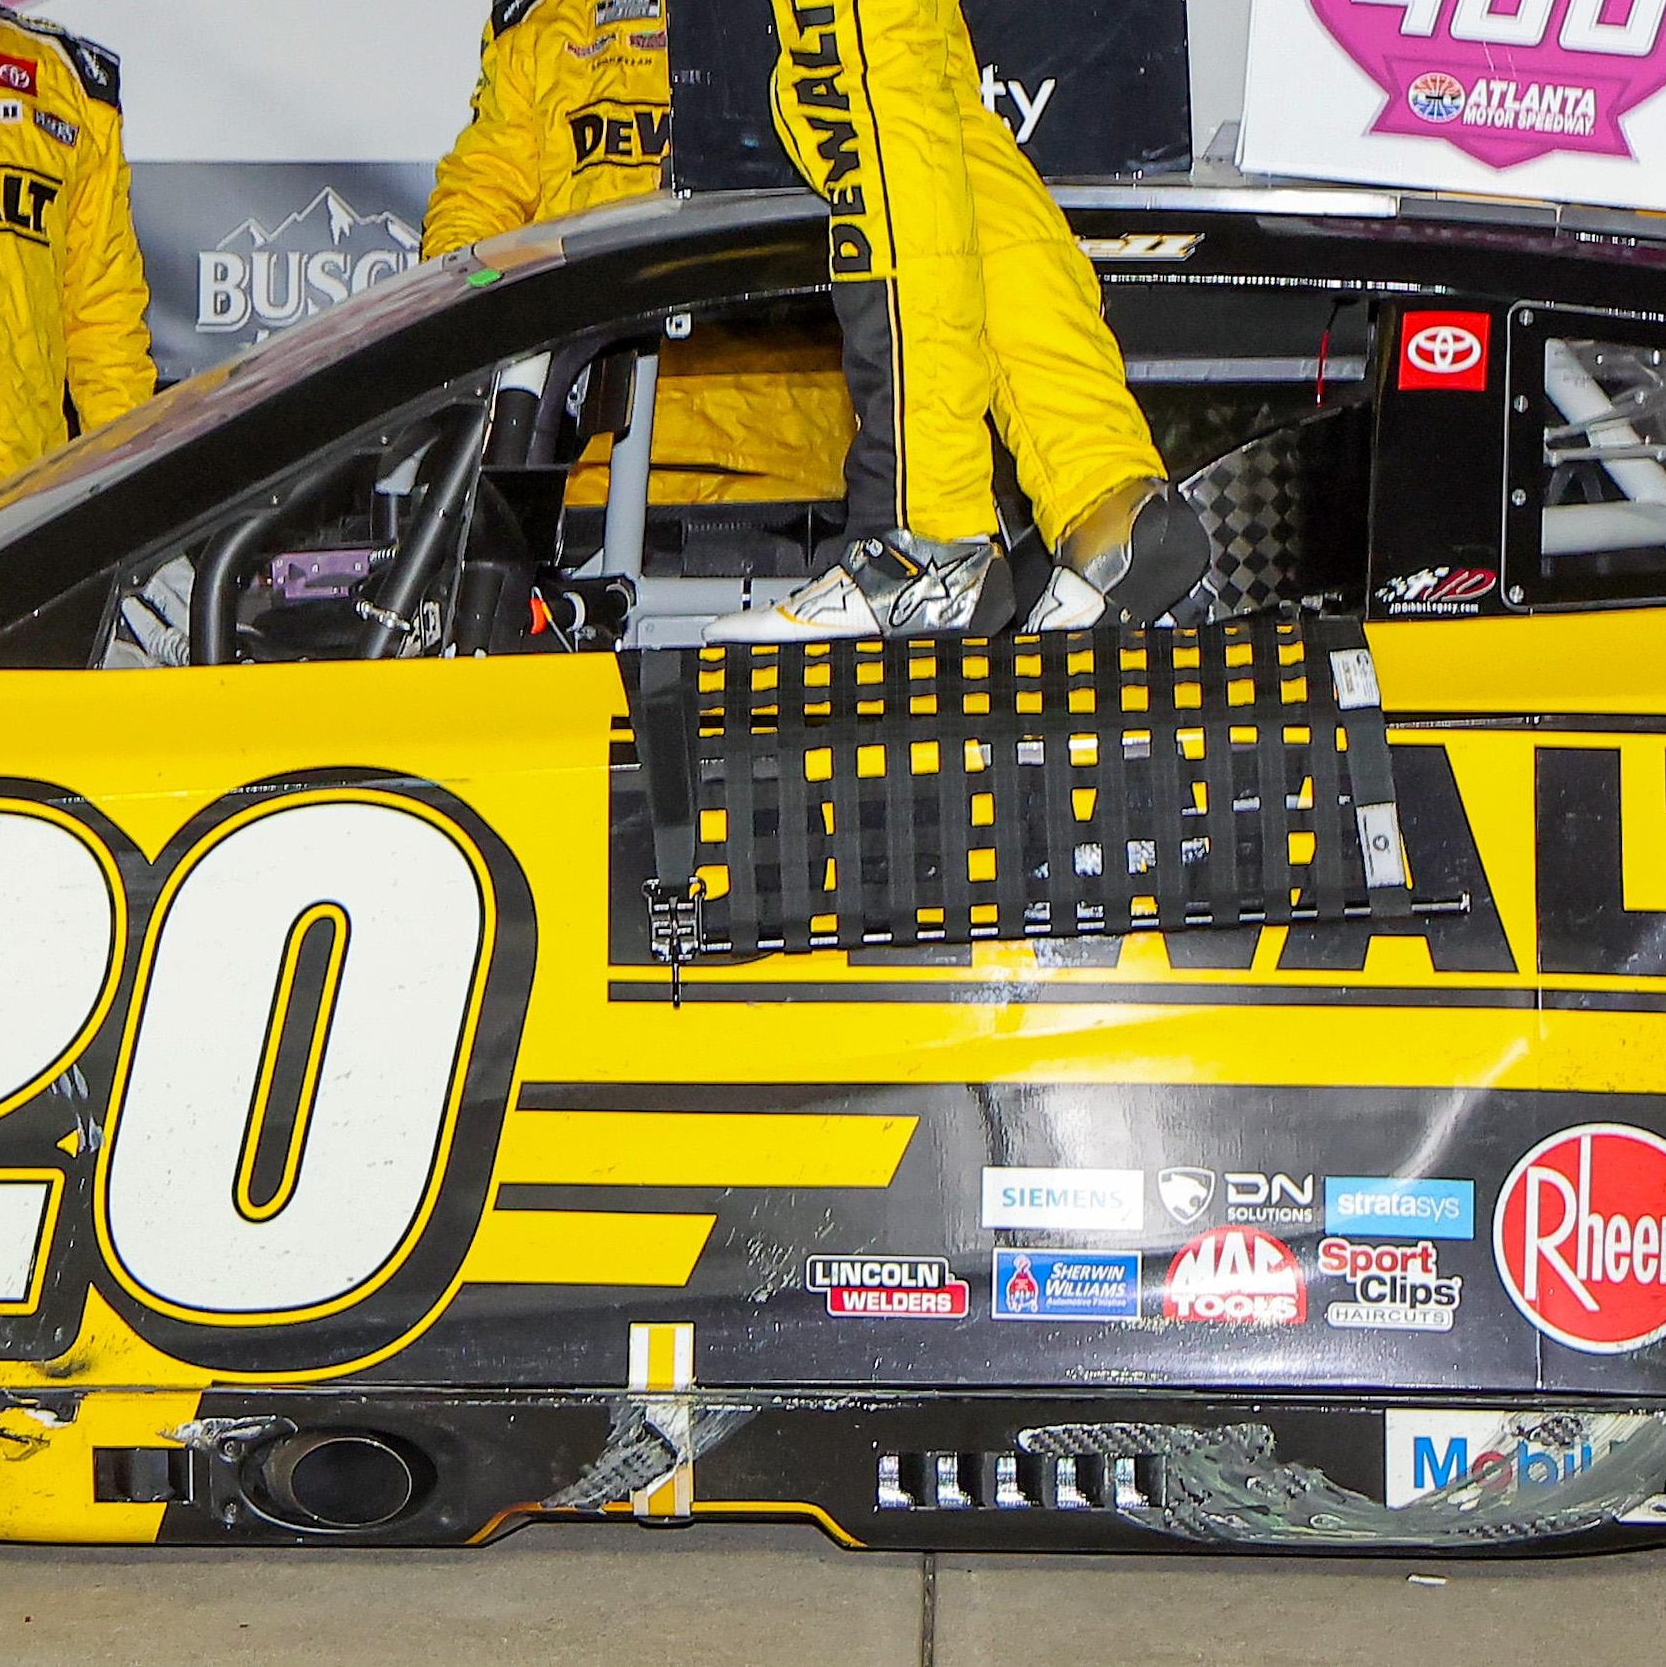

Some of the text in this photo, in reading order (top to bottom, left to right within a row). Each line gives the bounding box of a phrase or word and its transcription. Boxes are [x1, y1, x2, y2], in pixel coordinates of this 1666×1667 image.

[1465, 78, 1597, 118] ATLANTA
[570, 110, 671, 164] DEW
[1462, 107, 1595, 136] MOTOR SPEEDWAY
[790, 1, 874, 276] DEWALT
[1001, 1186, 1125, 1209] SIEMENS
[1225, 1173, 1315, 1206] DN
[1337, 1189, 1460, 1222] stratasys
[1227, 1206, 1313, 1222] SOLUTIONS
[814, 1261, 940, 1289] LINCOLN
[1051, 1262, 1126, 1282] SHERWIN
[1170, 1231, 1299, 1295] MAC
[1320, 1240, 1436, 1277] Sport
[842, 1290, 953, 1314] WELDERS
[1044, 1278, 1127, 1298] WILLIAMS
[1355, 1274, 1458, 1307] Clips
[1334, 1308, 1445, 1325] HAIRCUTS
[1413, 1434, 1594, 1491] Mobil
